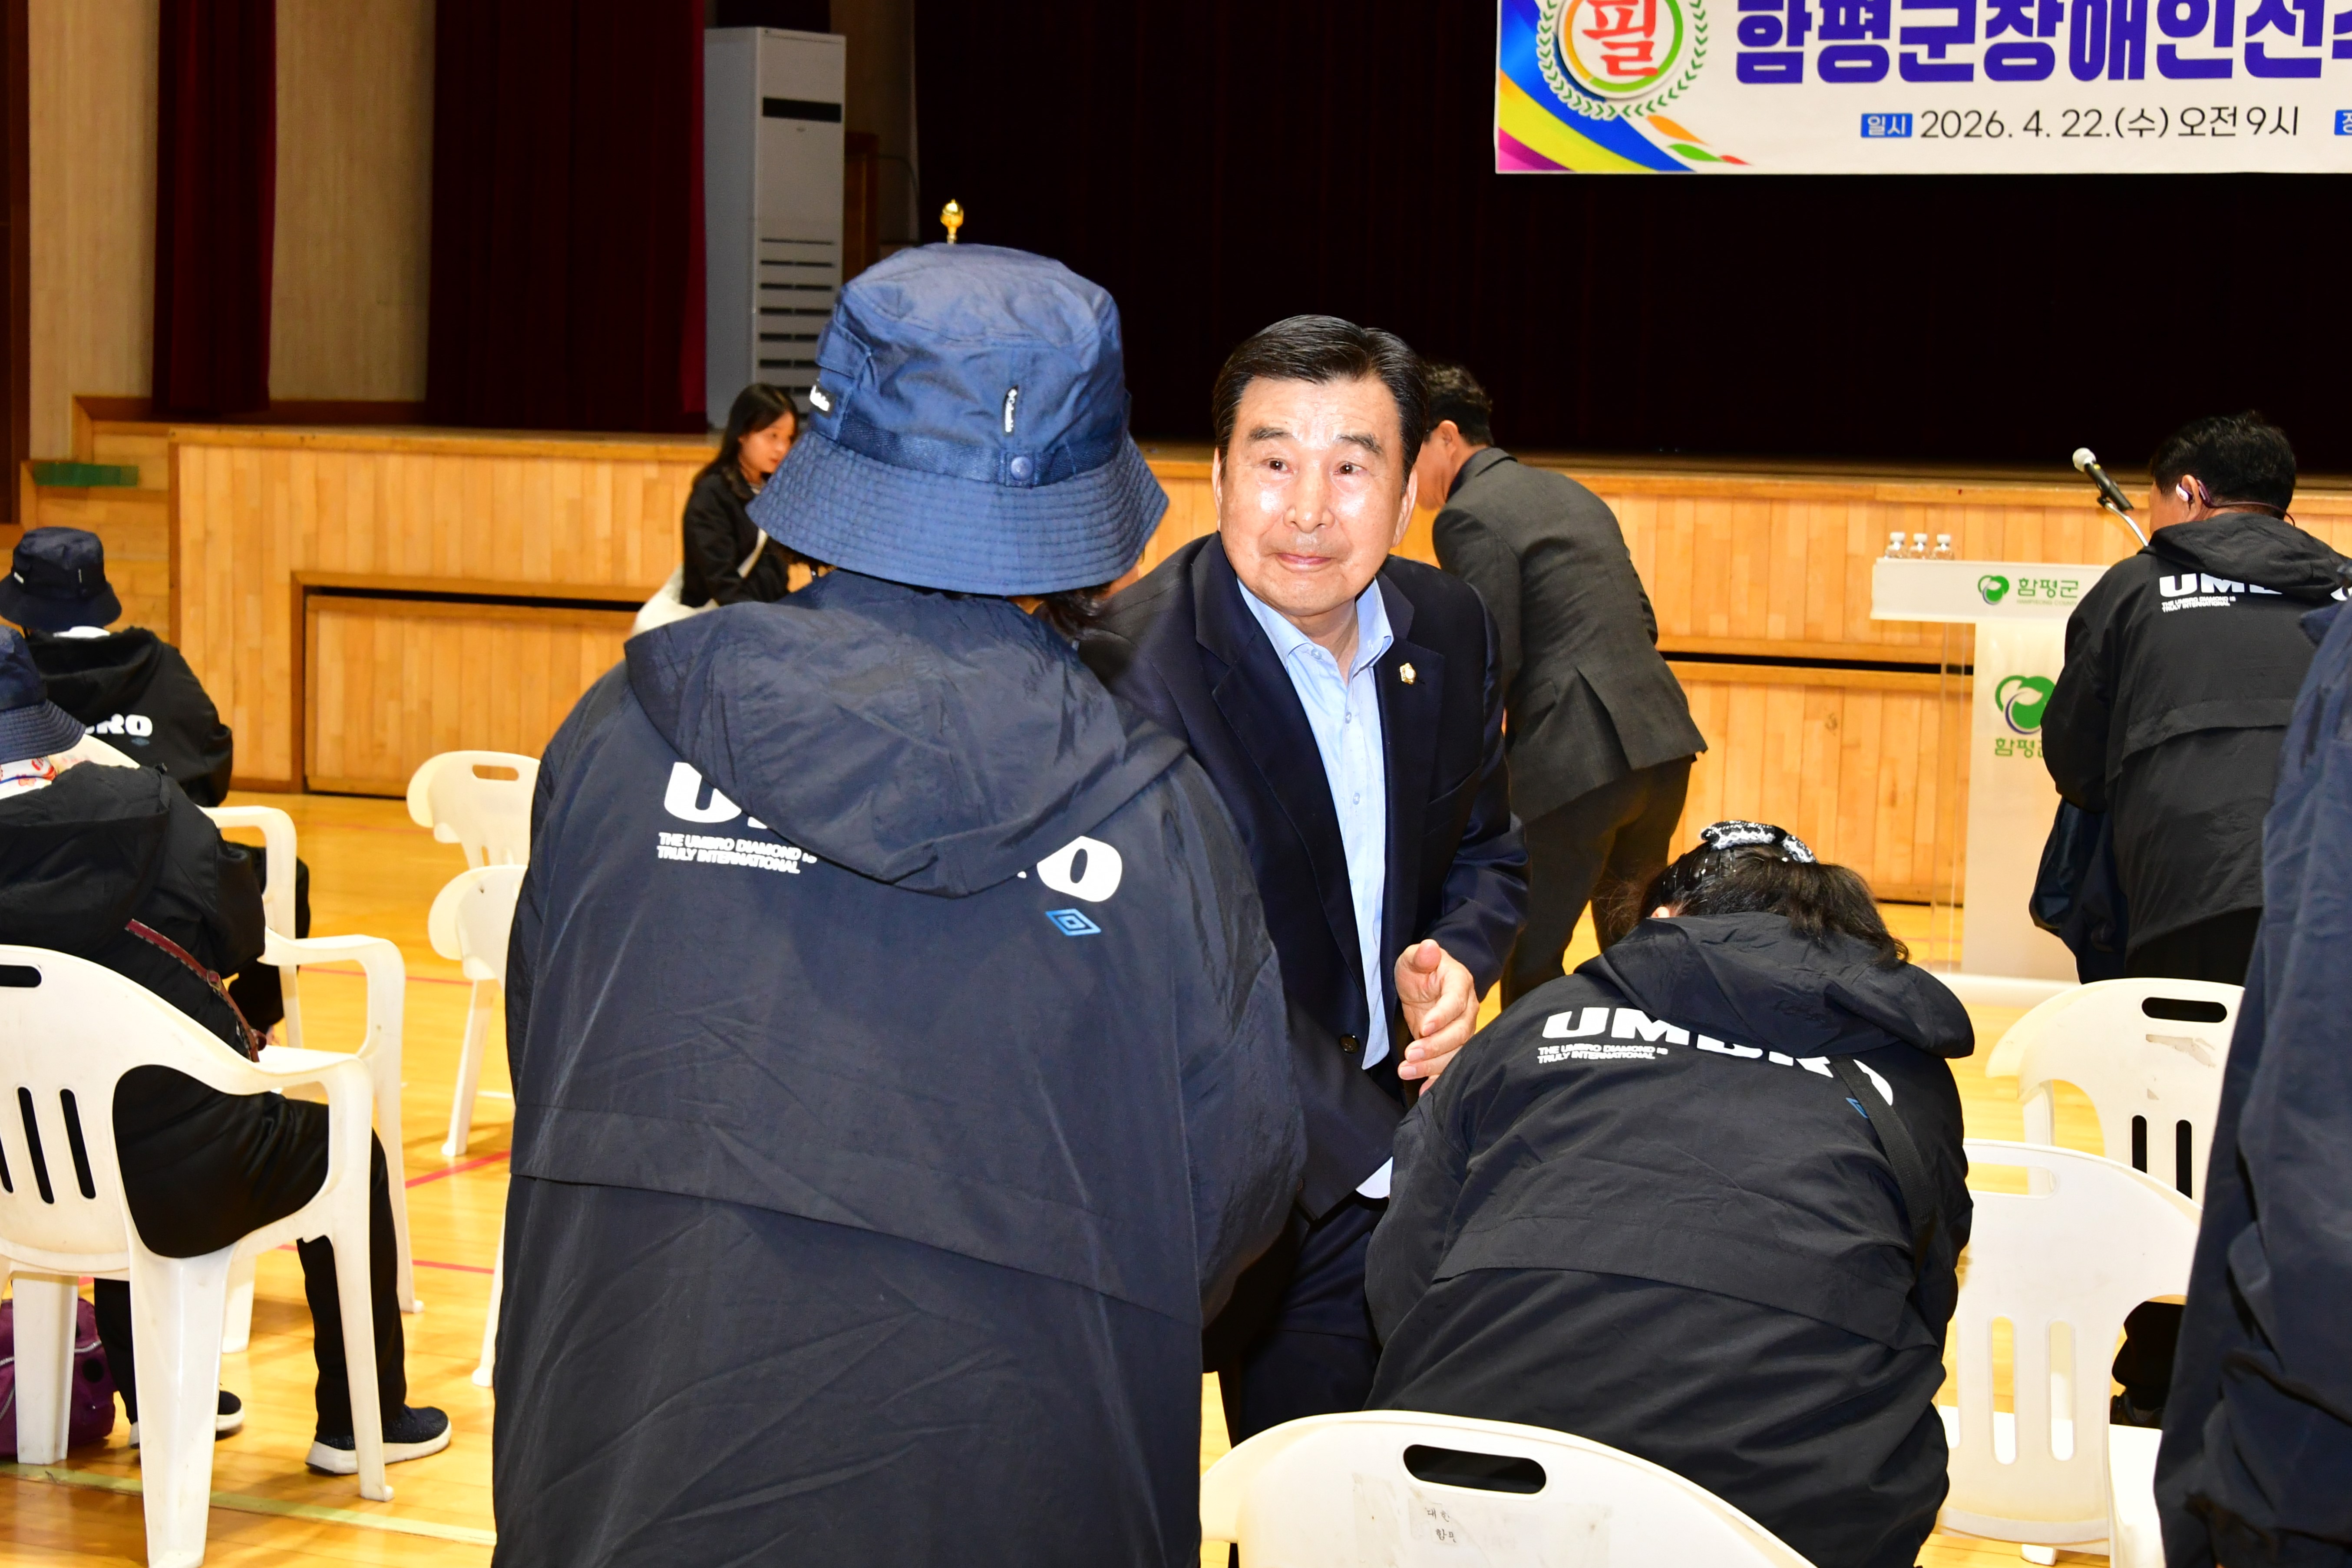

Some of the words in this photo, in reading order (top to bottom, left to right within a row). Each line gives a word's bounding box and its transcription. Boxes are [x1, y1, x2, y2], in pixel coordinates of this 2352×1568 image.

[1868, 115, 1906, 136] 일시
[1920, 110, 2013, 138] 2026.
[2023, 109, 2051, 138] 4.
[2178, 106, 2237, 137] 오전
[2246, 106, 2298, 136] 9시
[2018, 578, 2078, 598] 함평군
[1995, 738, 2043, 758] 함평
[657, 845, 697, 861] TRULY
[658, 832, 684, 847] THE
[685, 834, 735, 852] UMBRO
[735, 839, 802, 861] DIAMOND
[1537, 1052, 1571, 1064] TRULY
[1538, 1046, 1560, 1055] THE
[1561, 1043, 1602, 1053] UMBRO
[1603, 1044, 1656, 1053] DIAMOND
